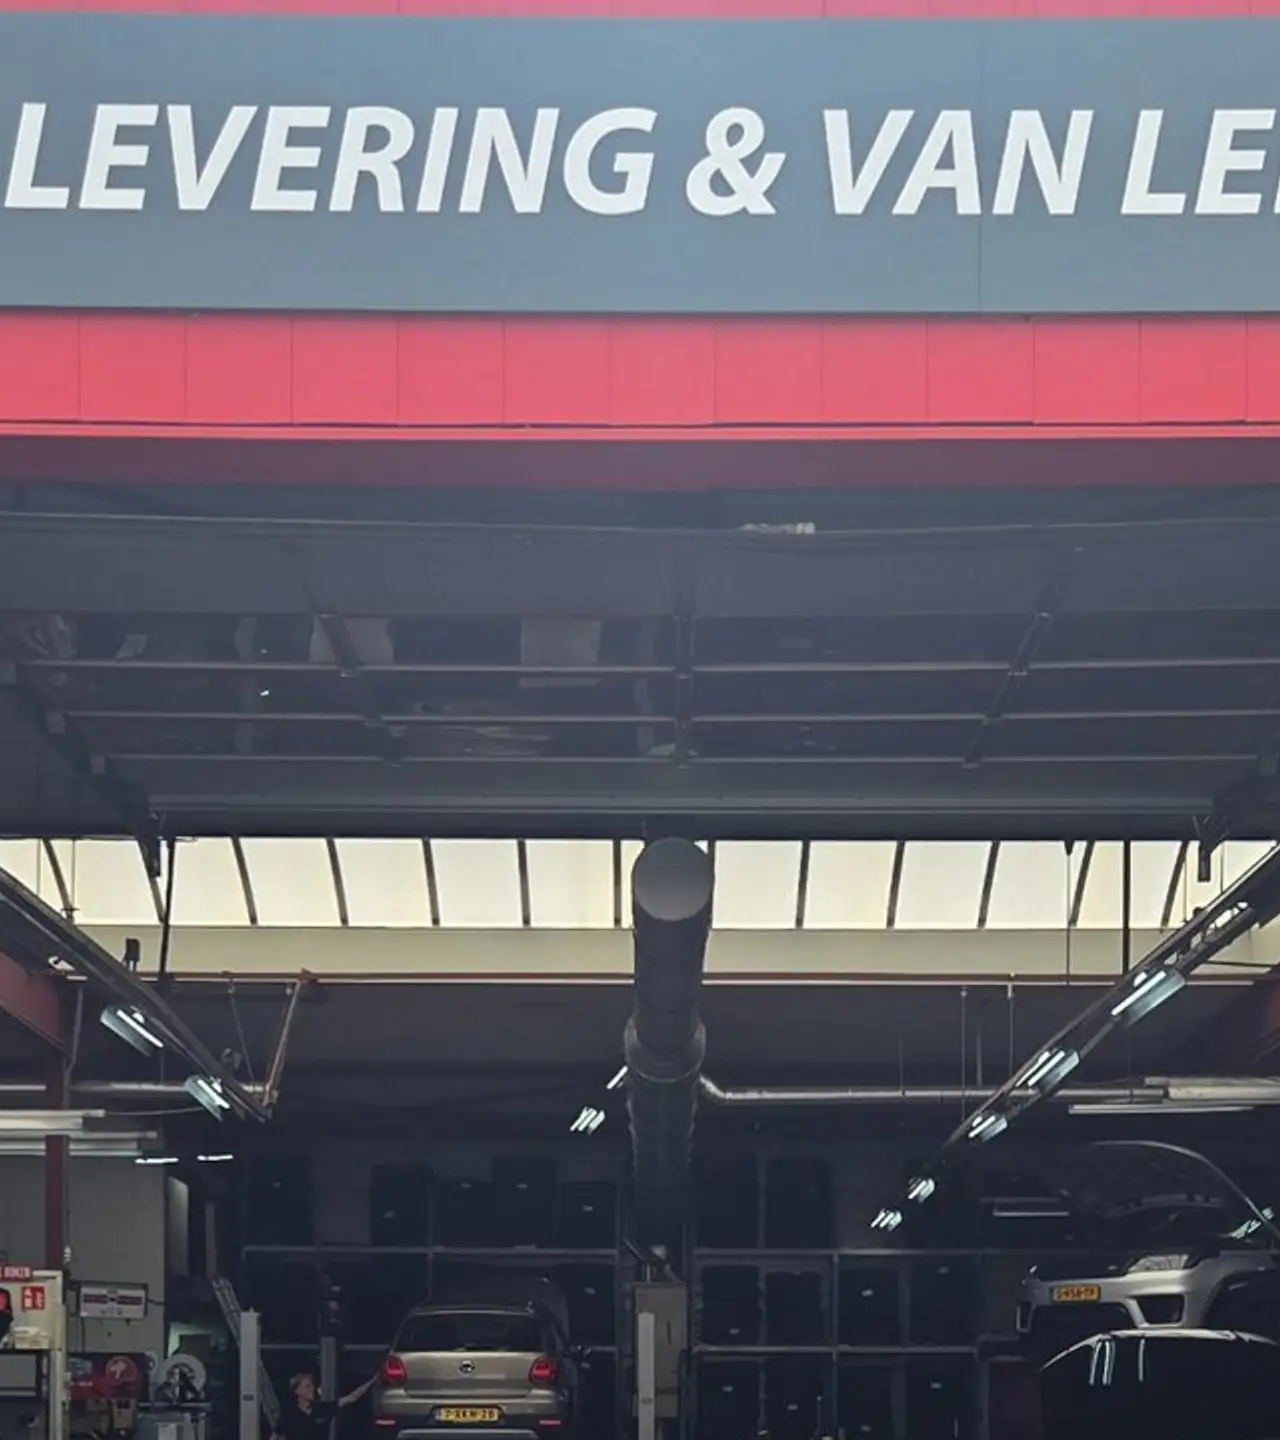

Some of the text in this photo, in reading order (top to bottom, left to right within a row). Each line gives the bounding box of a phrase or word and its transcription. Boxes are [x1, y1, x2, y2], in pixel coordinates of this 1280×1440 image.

[4, 102, 658, 215] LEVERING
[685, 107, 787, 215] &
[822, 109, 1094, 215] VAN
